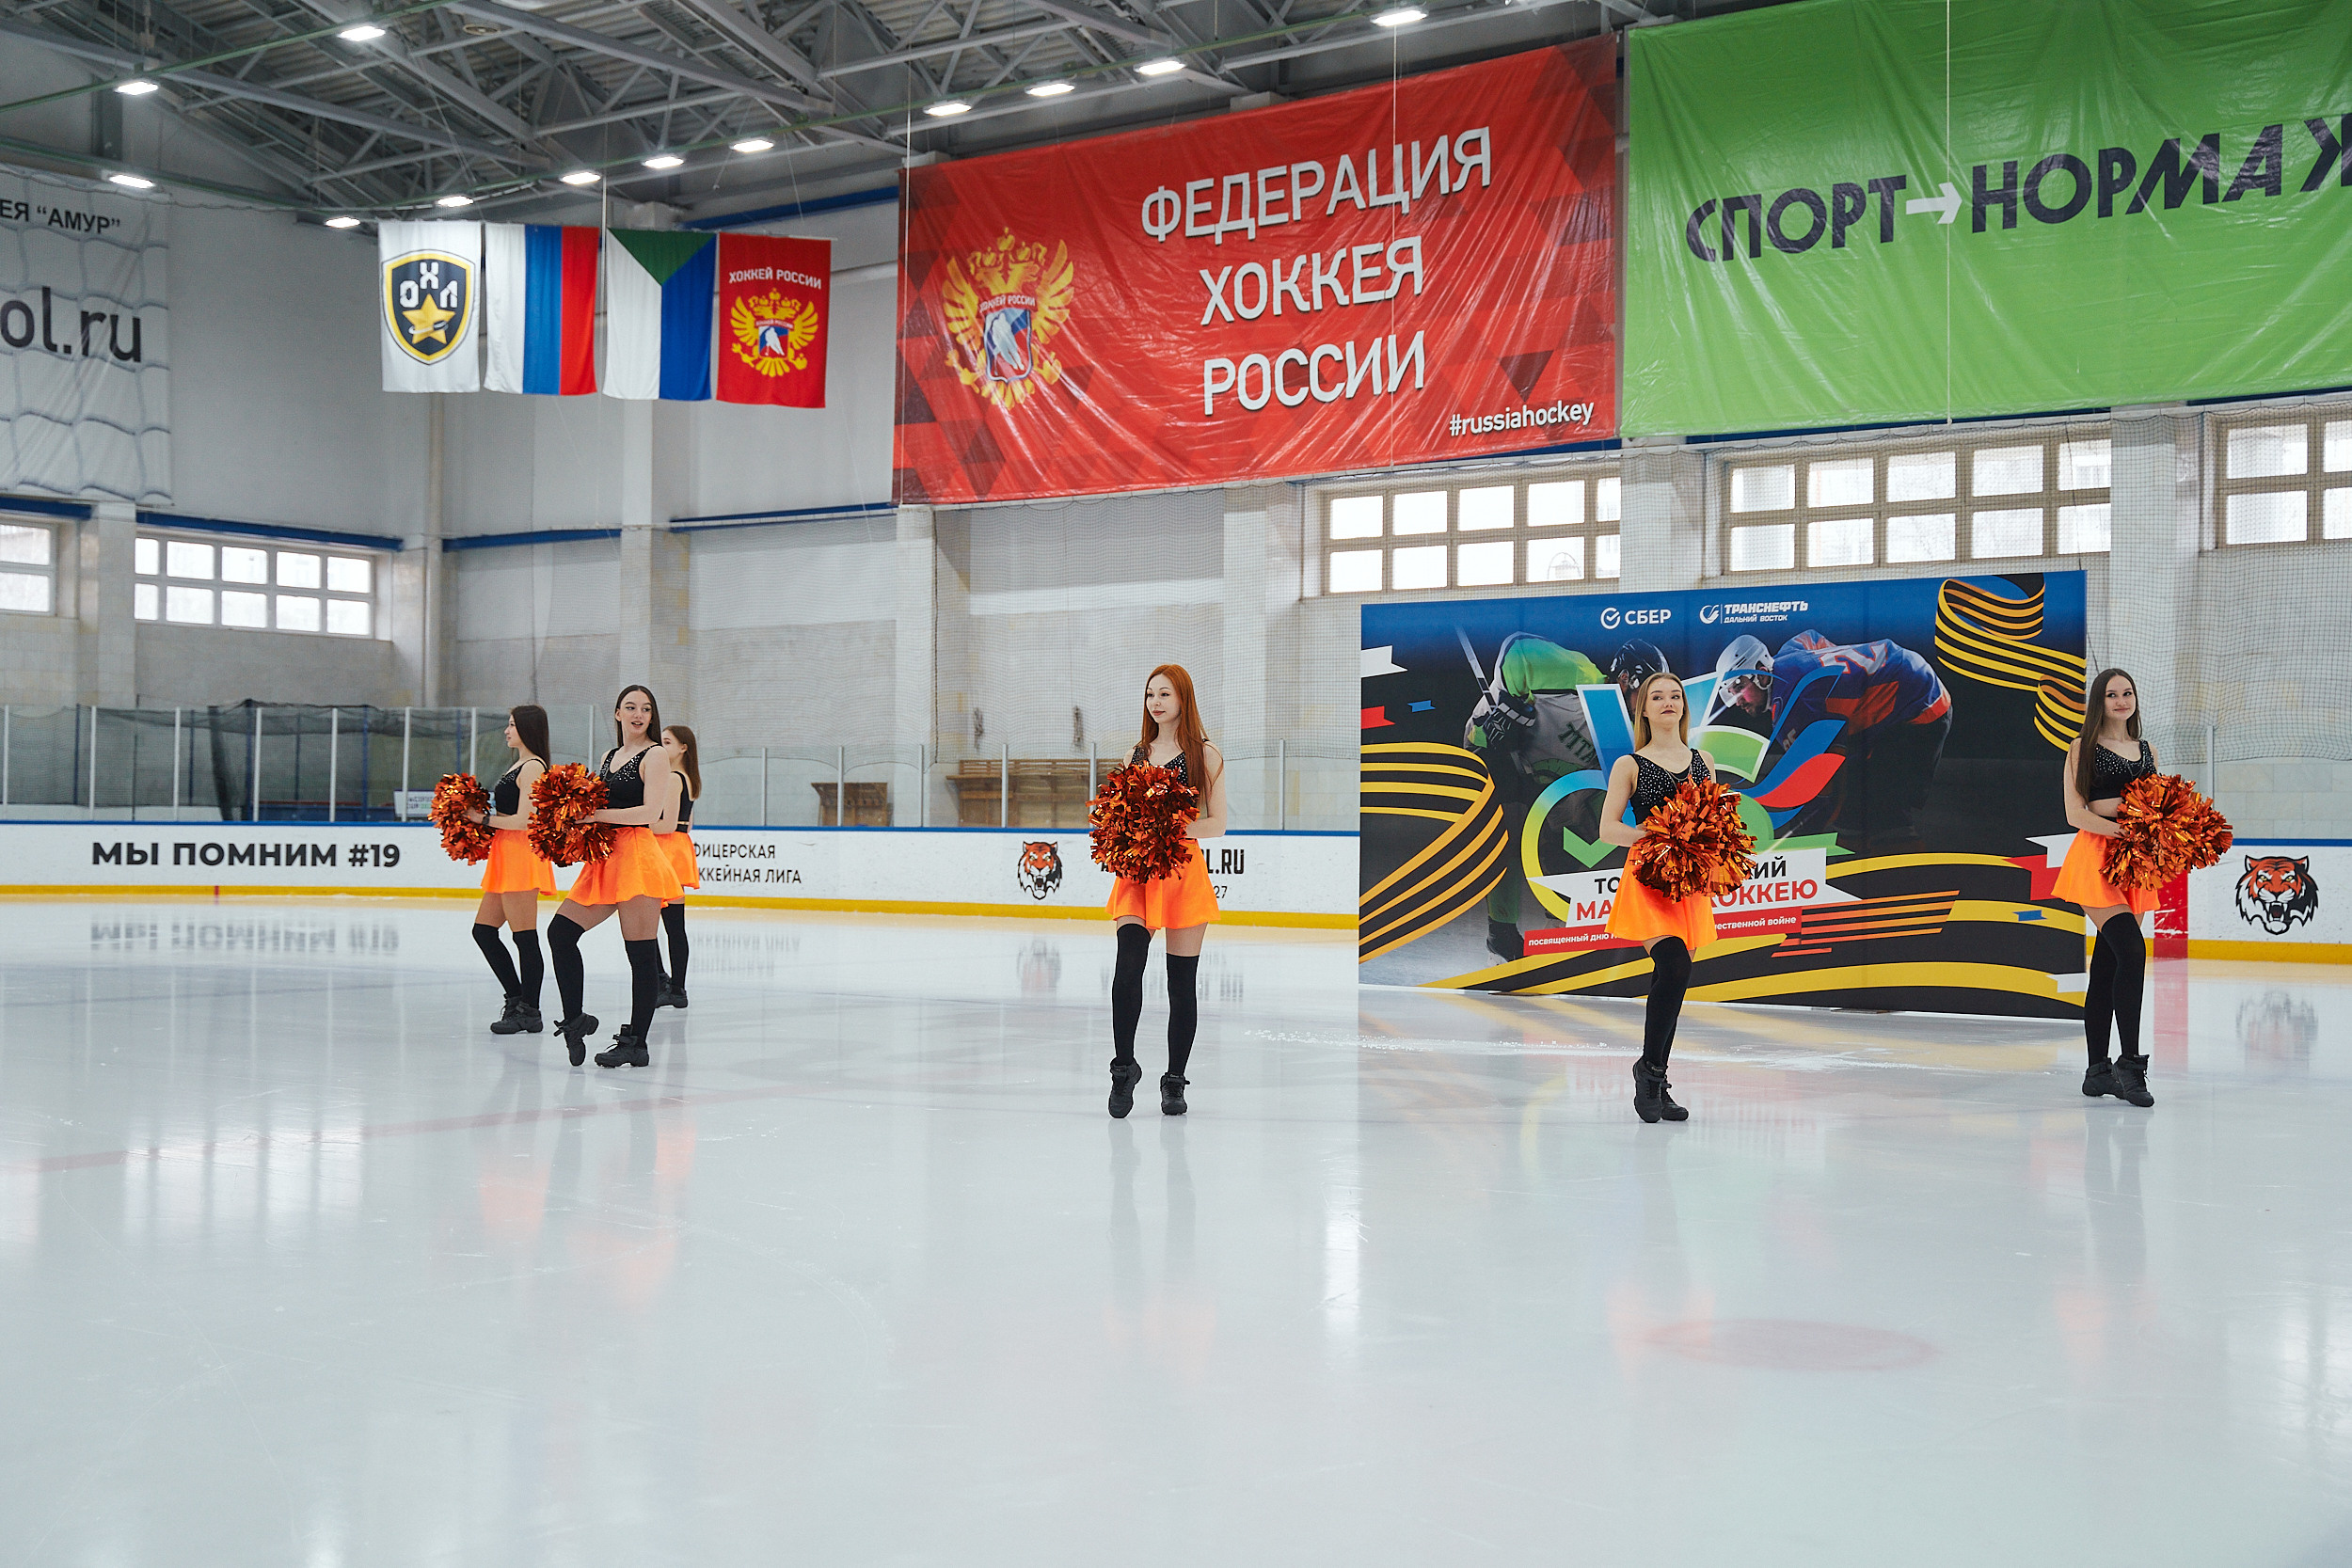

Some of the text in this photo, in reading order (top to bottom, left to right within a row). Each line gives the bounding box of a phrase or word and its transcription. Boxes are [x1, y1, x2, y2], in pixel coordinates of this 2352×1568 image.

[1141, 126, 1492, 245] ФЕДЕРАЦИЯ
[1685, 174, 1907, 263] СПОРТ
[1971, 123, 2283, 234] НОРМА
[729, 266, 821, 290] ХОККЕЙ РОССИИ
[1200, 235, 1424, 325] ХОККЕЯ
[0, 285, 141, 363] ol.ru
[1203, 330, 1425, 415] РОССИИ
[1449, 400, 1595, 437] #russiahockey
[1624, 609, 1672, 625] СБЕР
[1724, 600, 1809, 614] ТРАНСНЕФТЬ
[1724, 614, 1788, 624] ДАЛЬНИЙ ВОСТОК
[92, 842, 401, 867] МЫ ПОМНИМ #19
[1202, 848, 1245, 874] L.RU
[1749, 855, 1787, 880] ИЙ
[765, 868, 802, 883] ЛИГА
[1711, 879, 1819, 909] ОККЕЮ
[1528, 933, 1589, 947] посвященный
[1590, 932, 1610, 942] дню
[1767, 916, 1797, 927] войне
